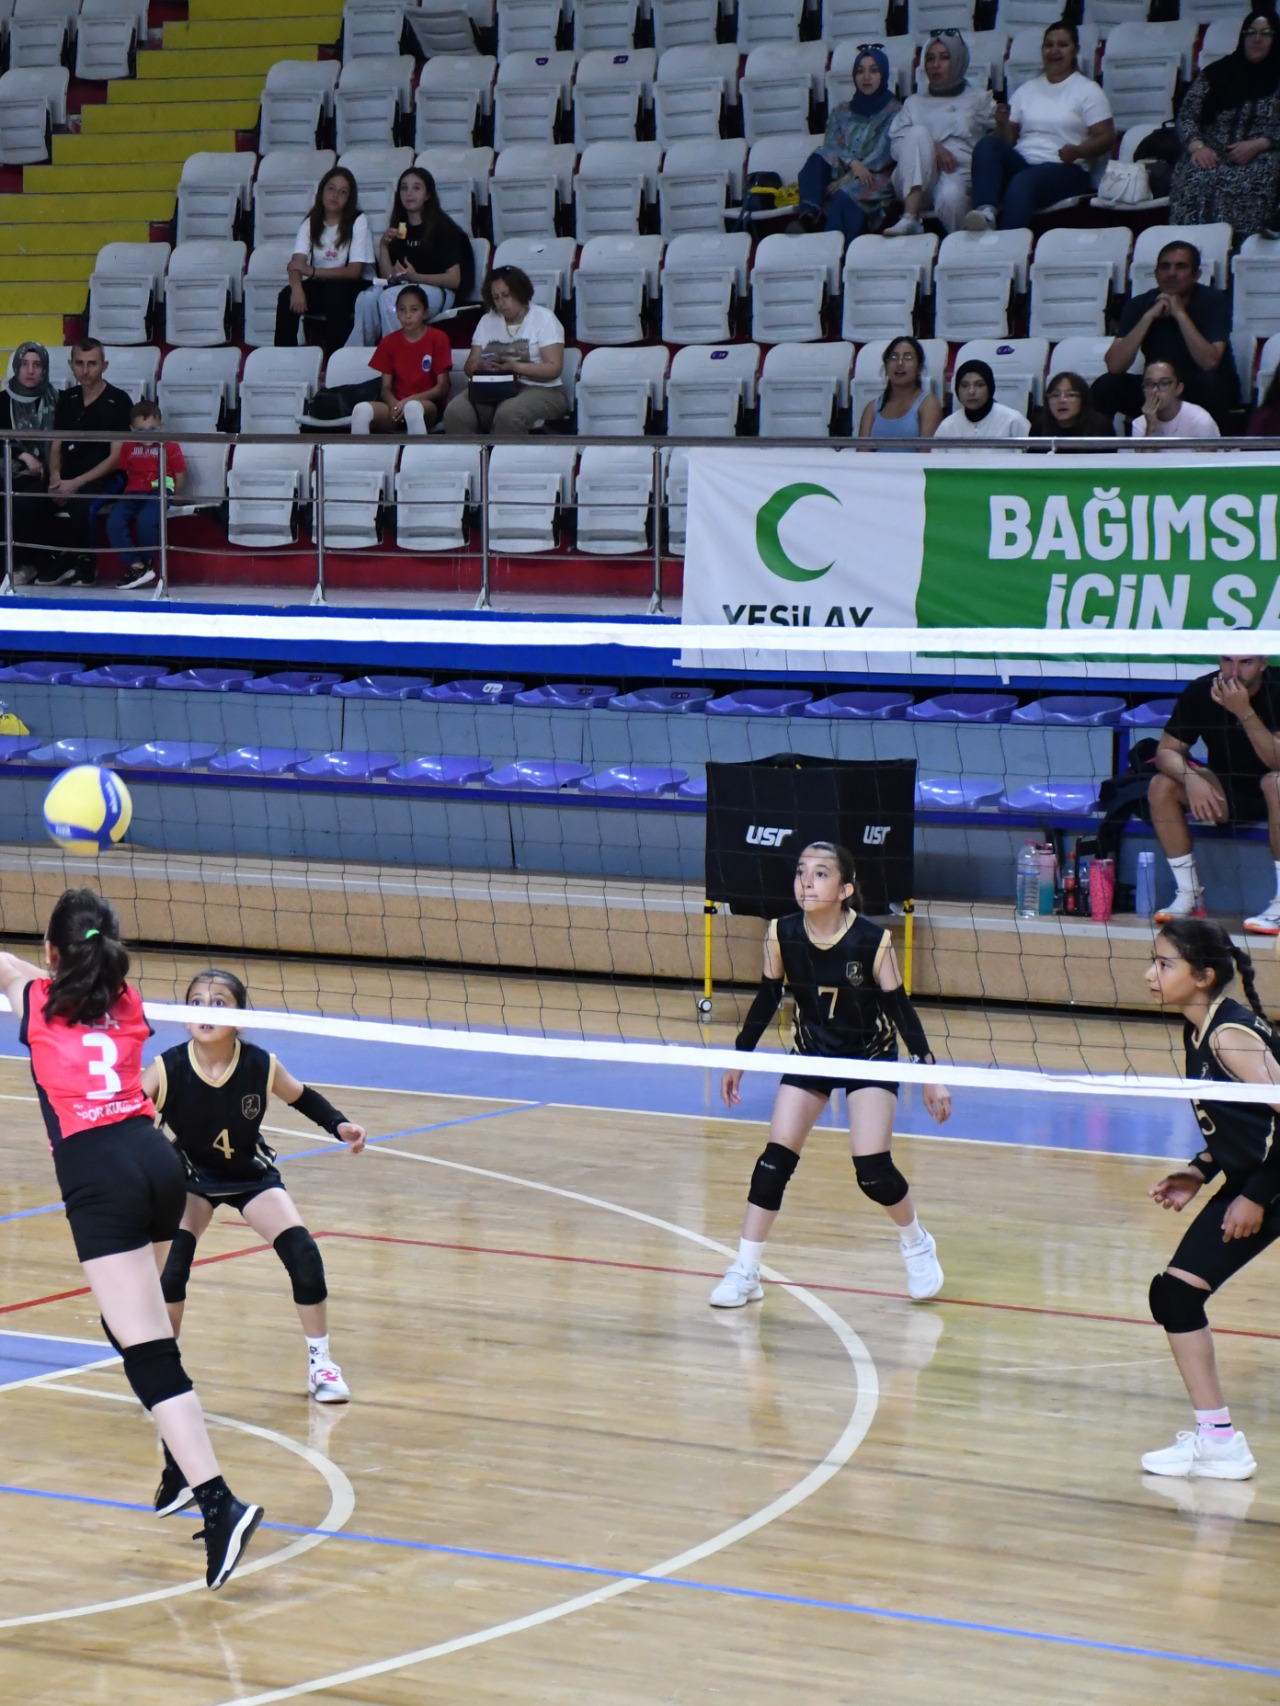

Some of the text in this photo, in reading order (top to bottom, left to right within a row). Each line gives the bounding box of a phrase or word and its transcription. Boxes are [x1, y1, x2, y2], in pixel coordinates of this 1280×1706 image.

[988, 487, 1279, 562] BAĞIMSI
[817, 985, 839, 1019] 7
[81, 1032, 122, 1100] 3
[212, 1128, 235, 1160] 4
